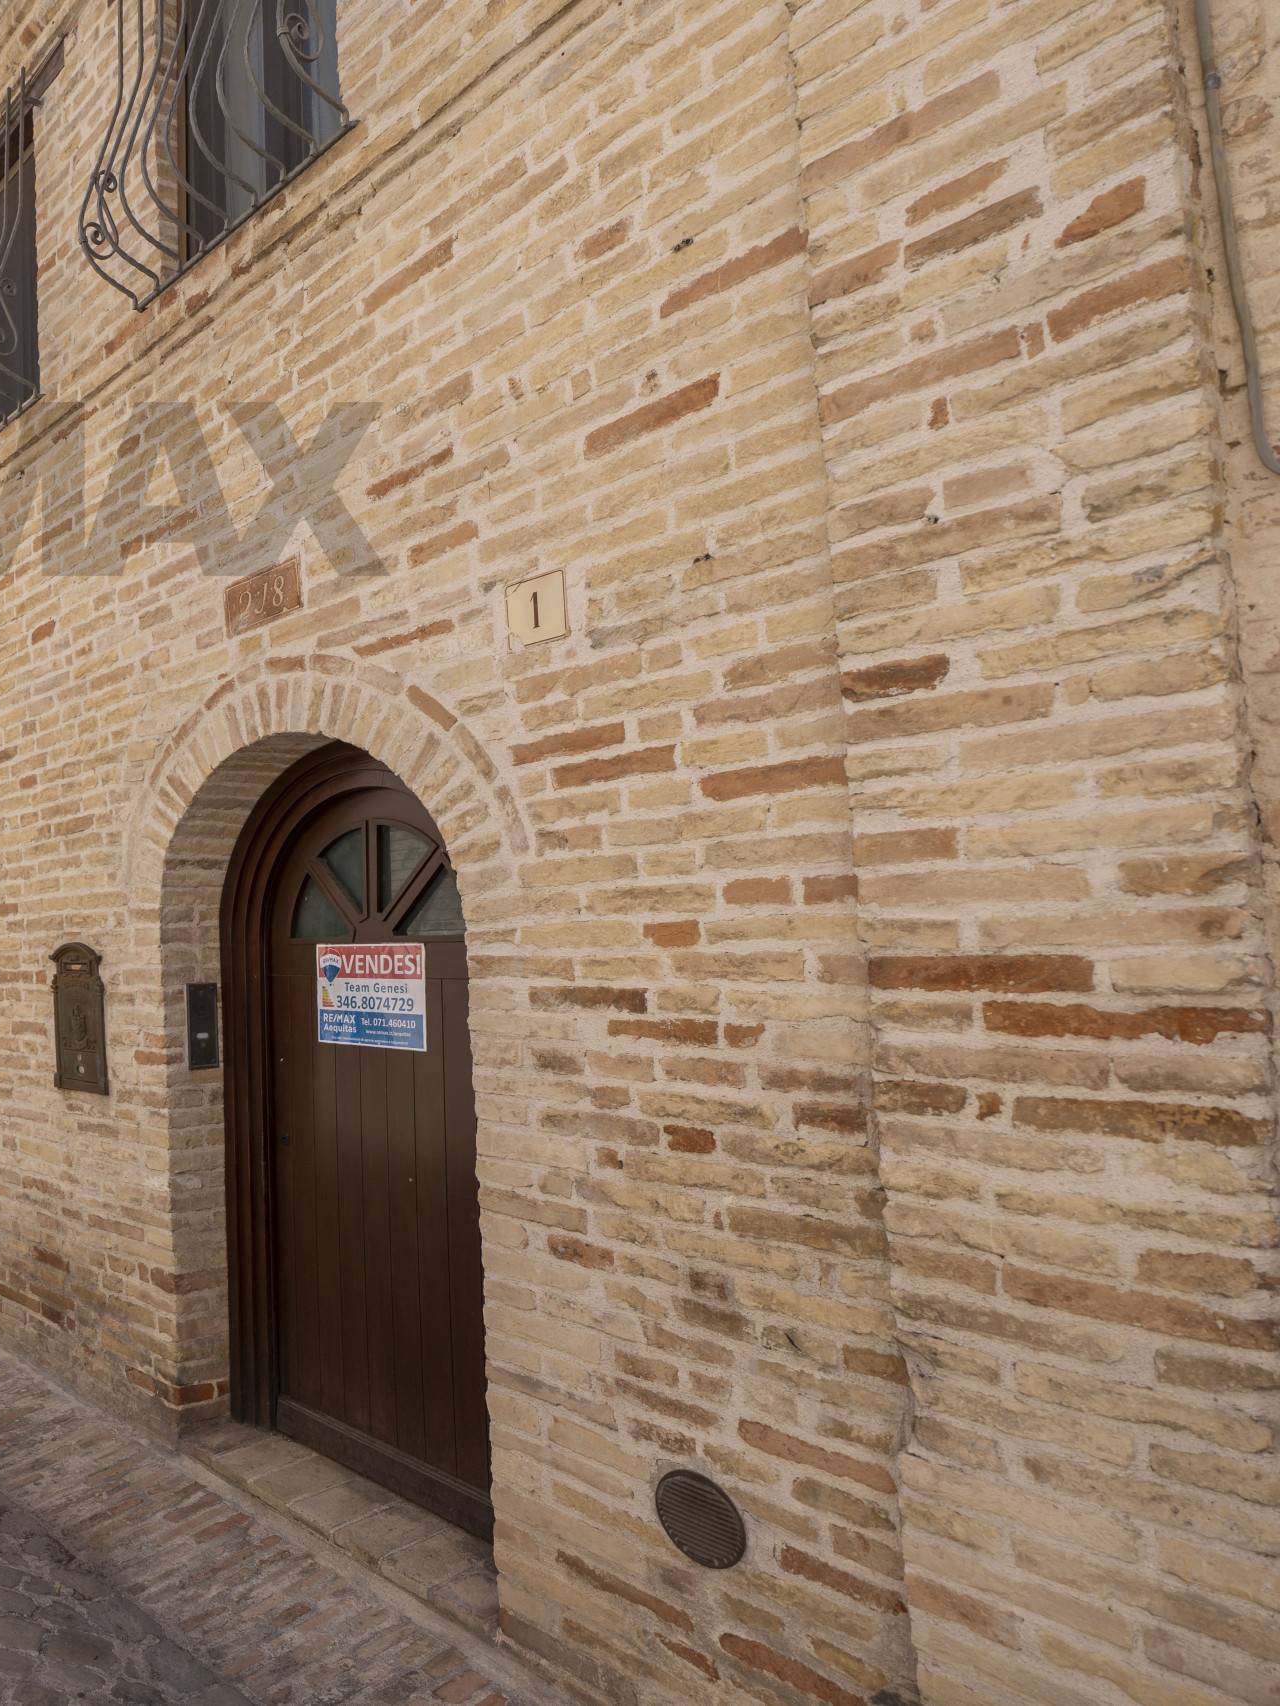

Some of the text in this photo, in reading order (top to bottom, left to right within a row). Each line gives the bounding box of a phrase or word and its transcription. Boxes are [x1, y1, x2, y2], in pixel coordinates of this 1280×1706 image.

[529, 591, 541, 629] 1
[341, 954, 421, 975] VENDESI
[344, 982, 408, 994] Team Genesi
[336, 995, 414, 1012] 346.8074729
[323, 1013, 356, 1024] RE/MAX
[361, 1018, 416, 1029] Tel. 071.460410
[323, 1023, 357, 1033] Aequitas
